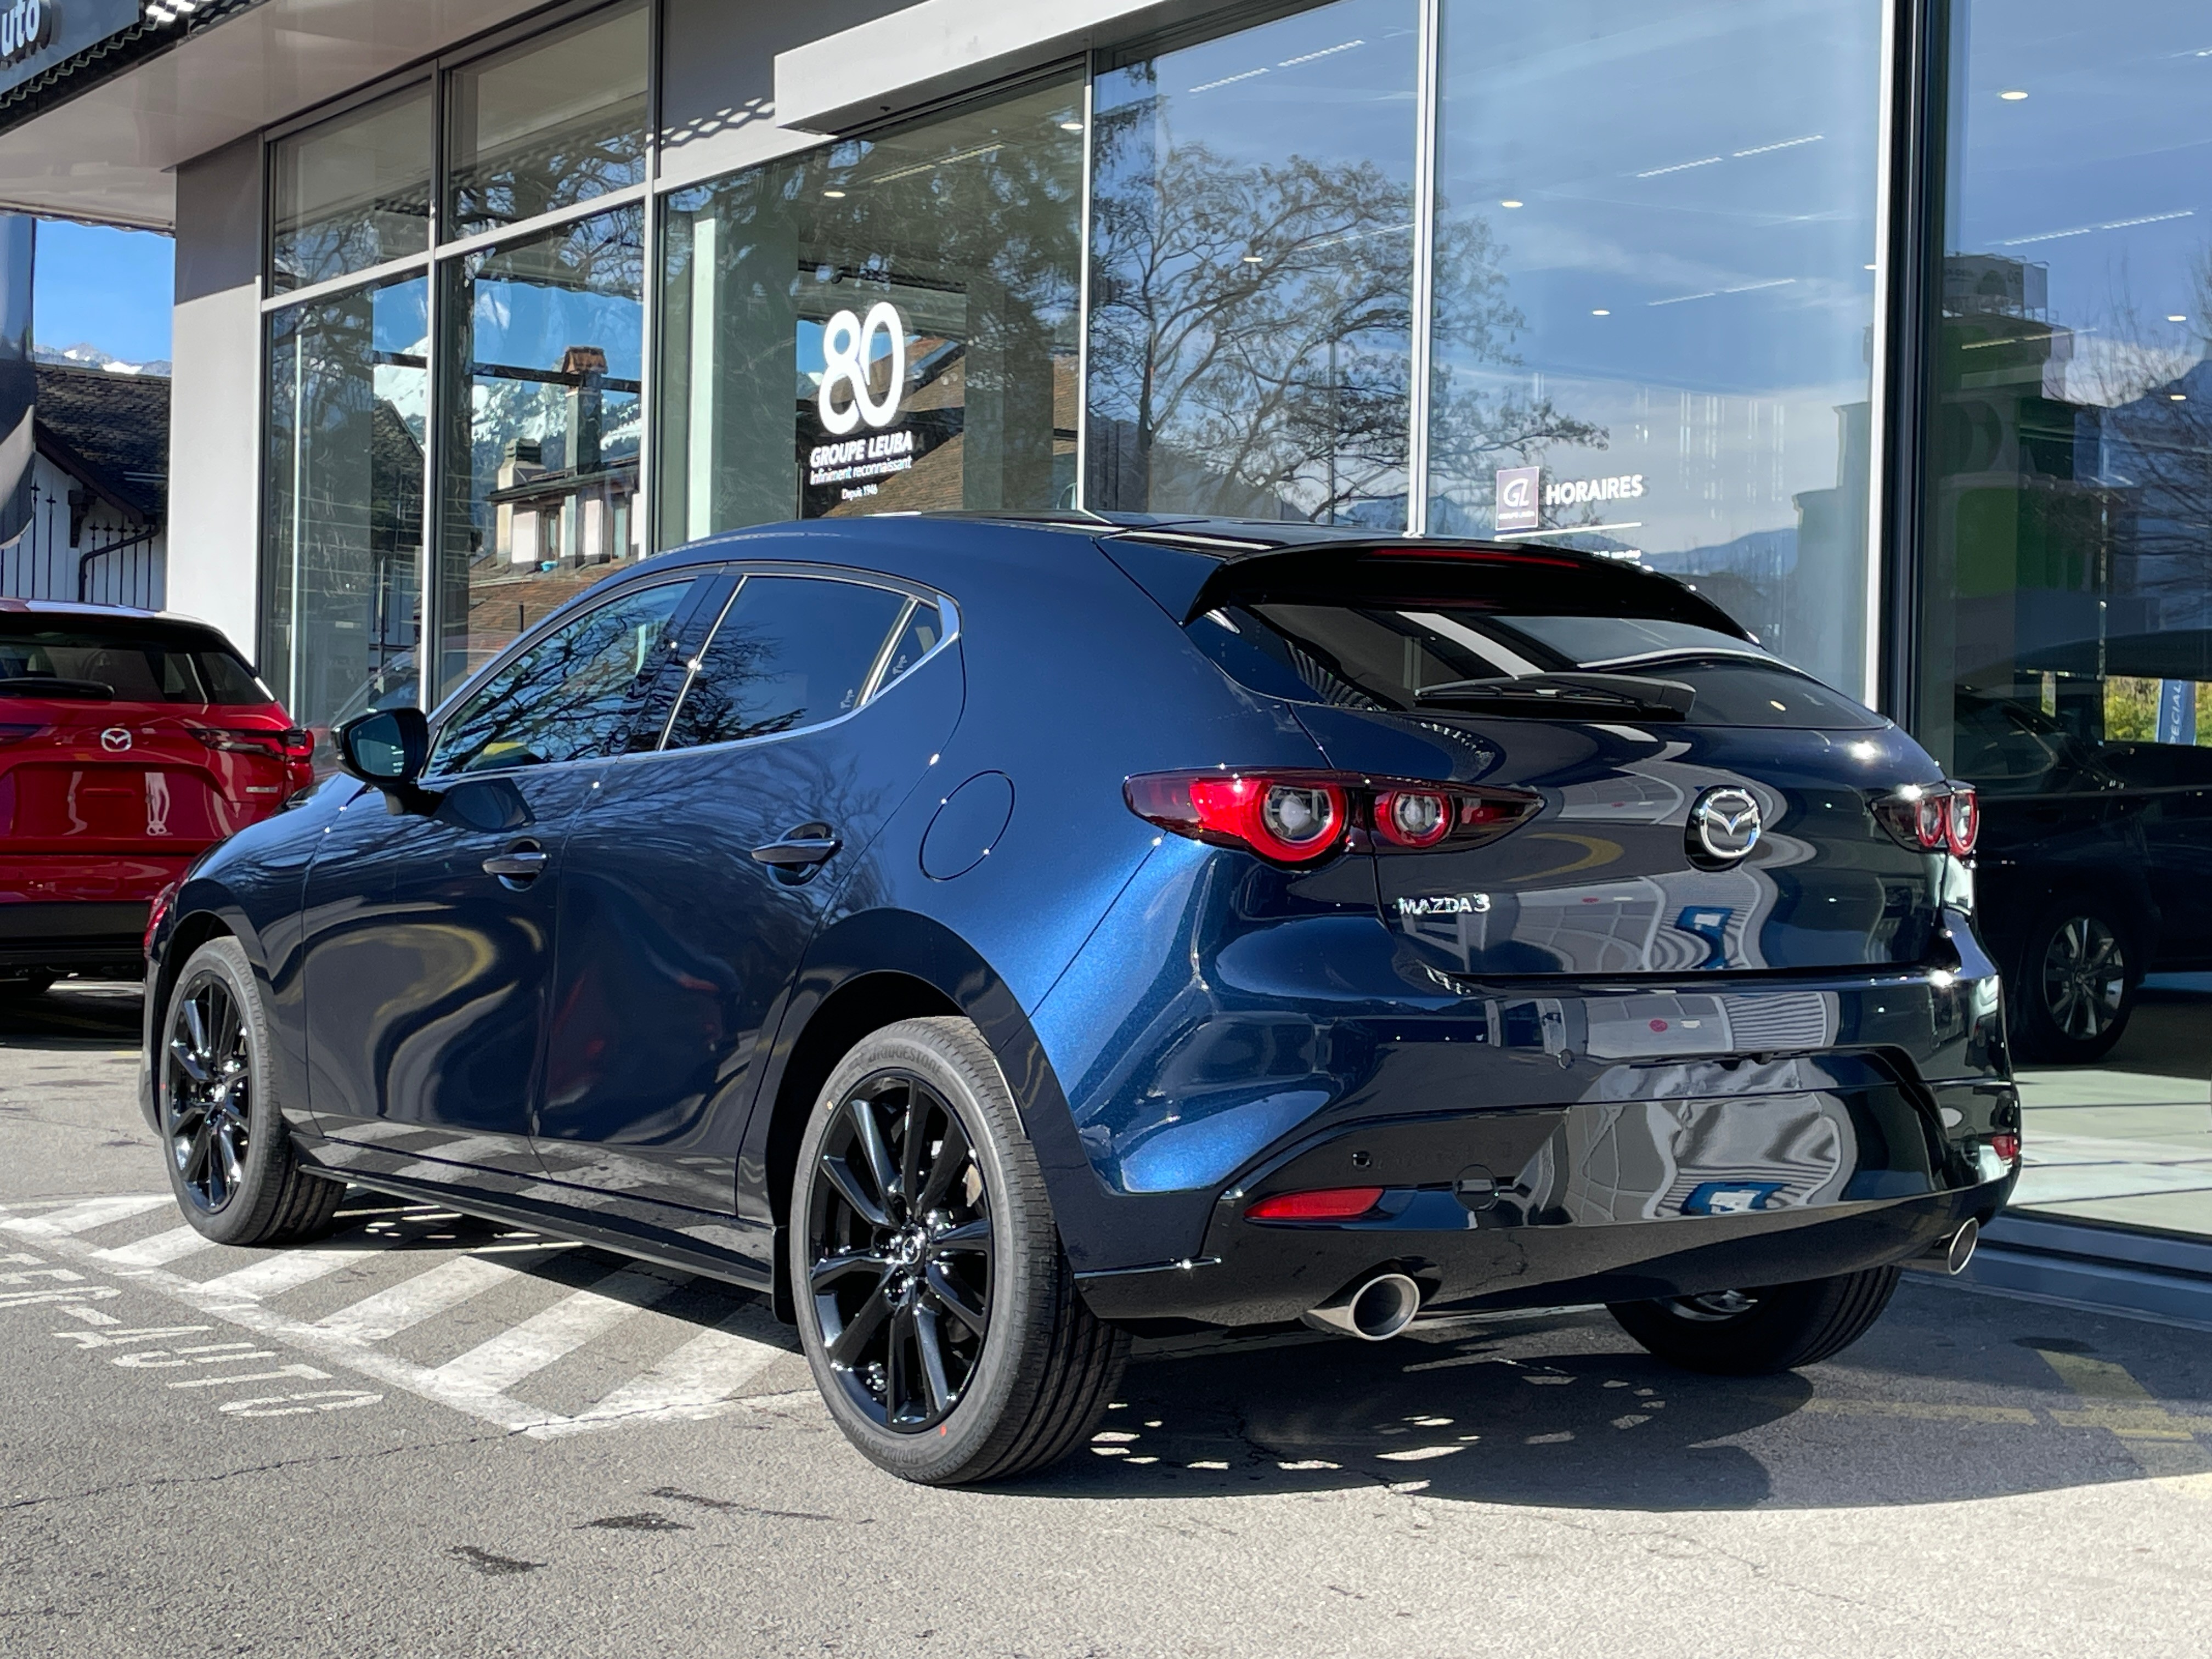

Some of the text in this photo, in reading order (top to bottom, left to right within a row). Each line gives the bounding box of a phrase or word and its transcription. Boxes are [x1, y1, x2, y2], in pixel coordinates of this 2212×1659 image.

[819, 302, 905, 435] 80
[810, 431, 913, 468] GROUPE LEUBA
[1545, 474, 1644, 506] HORAIRES
